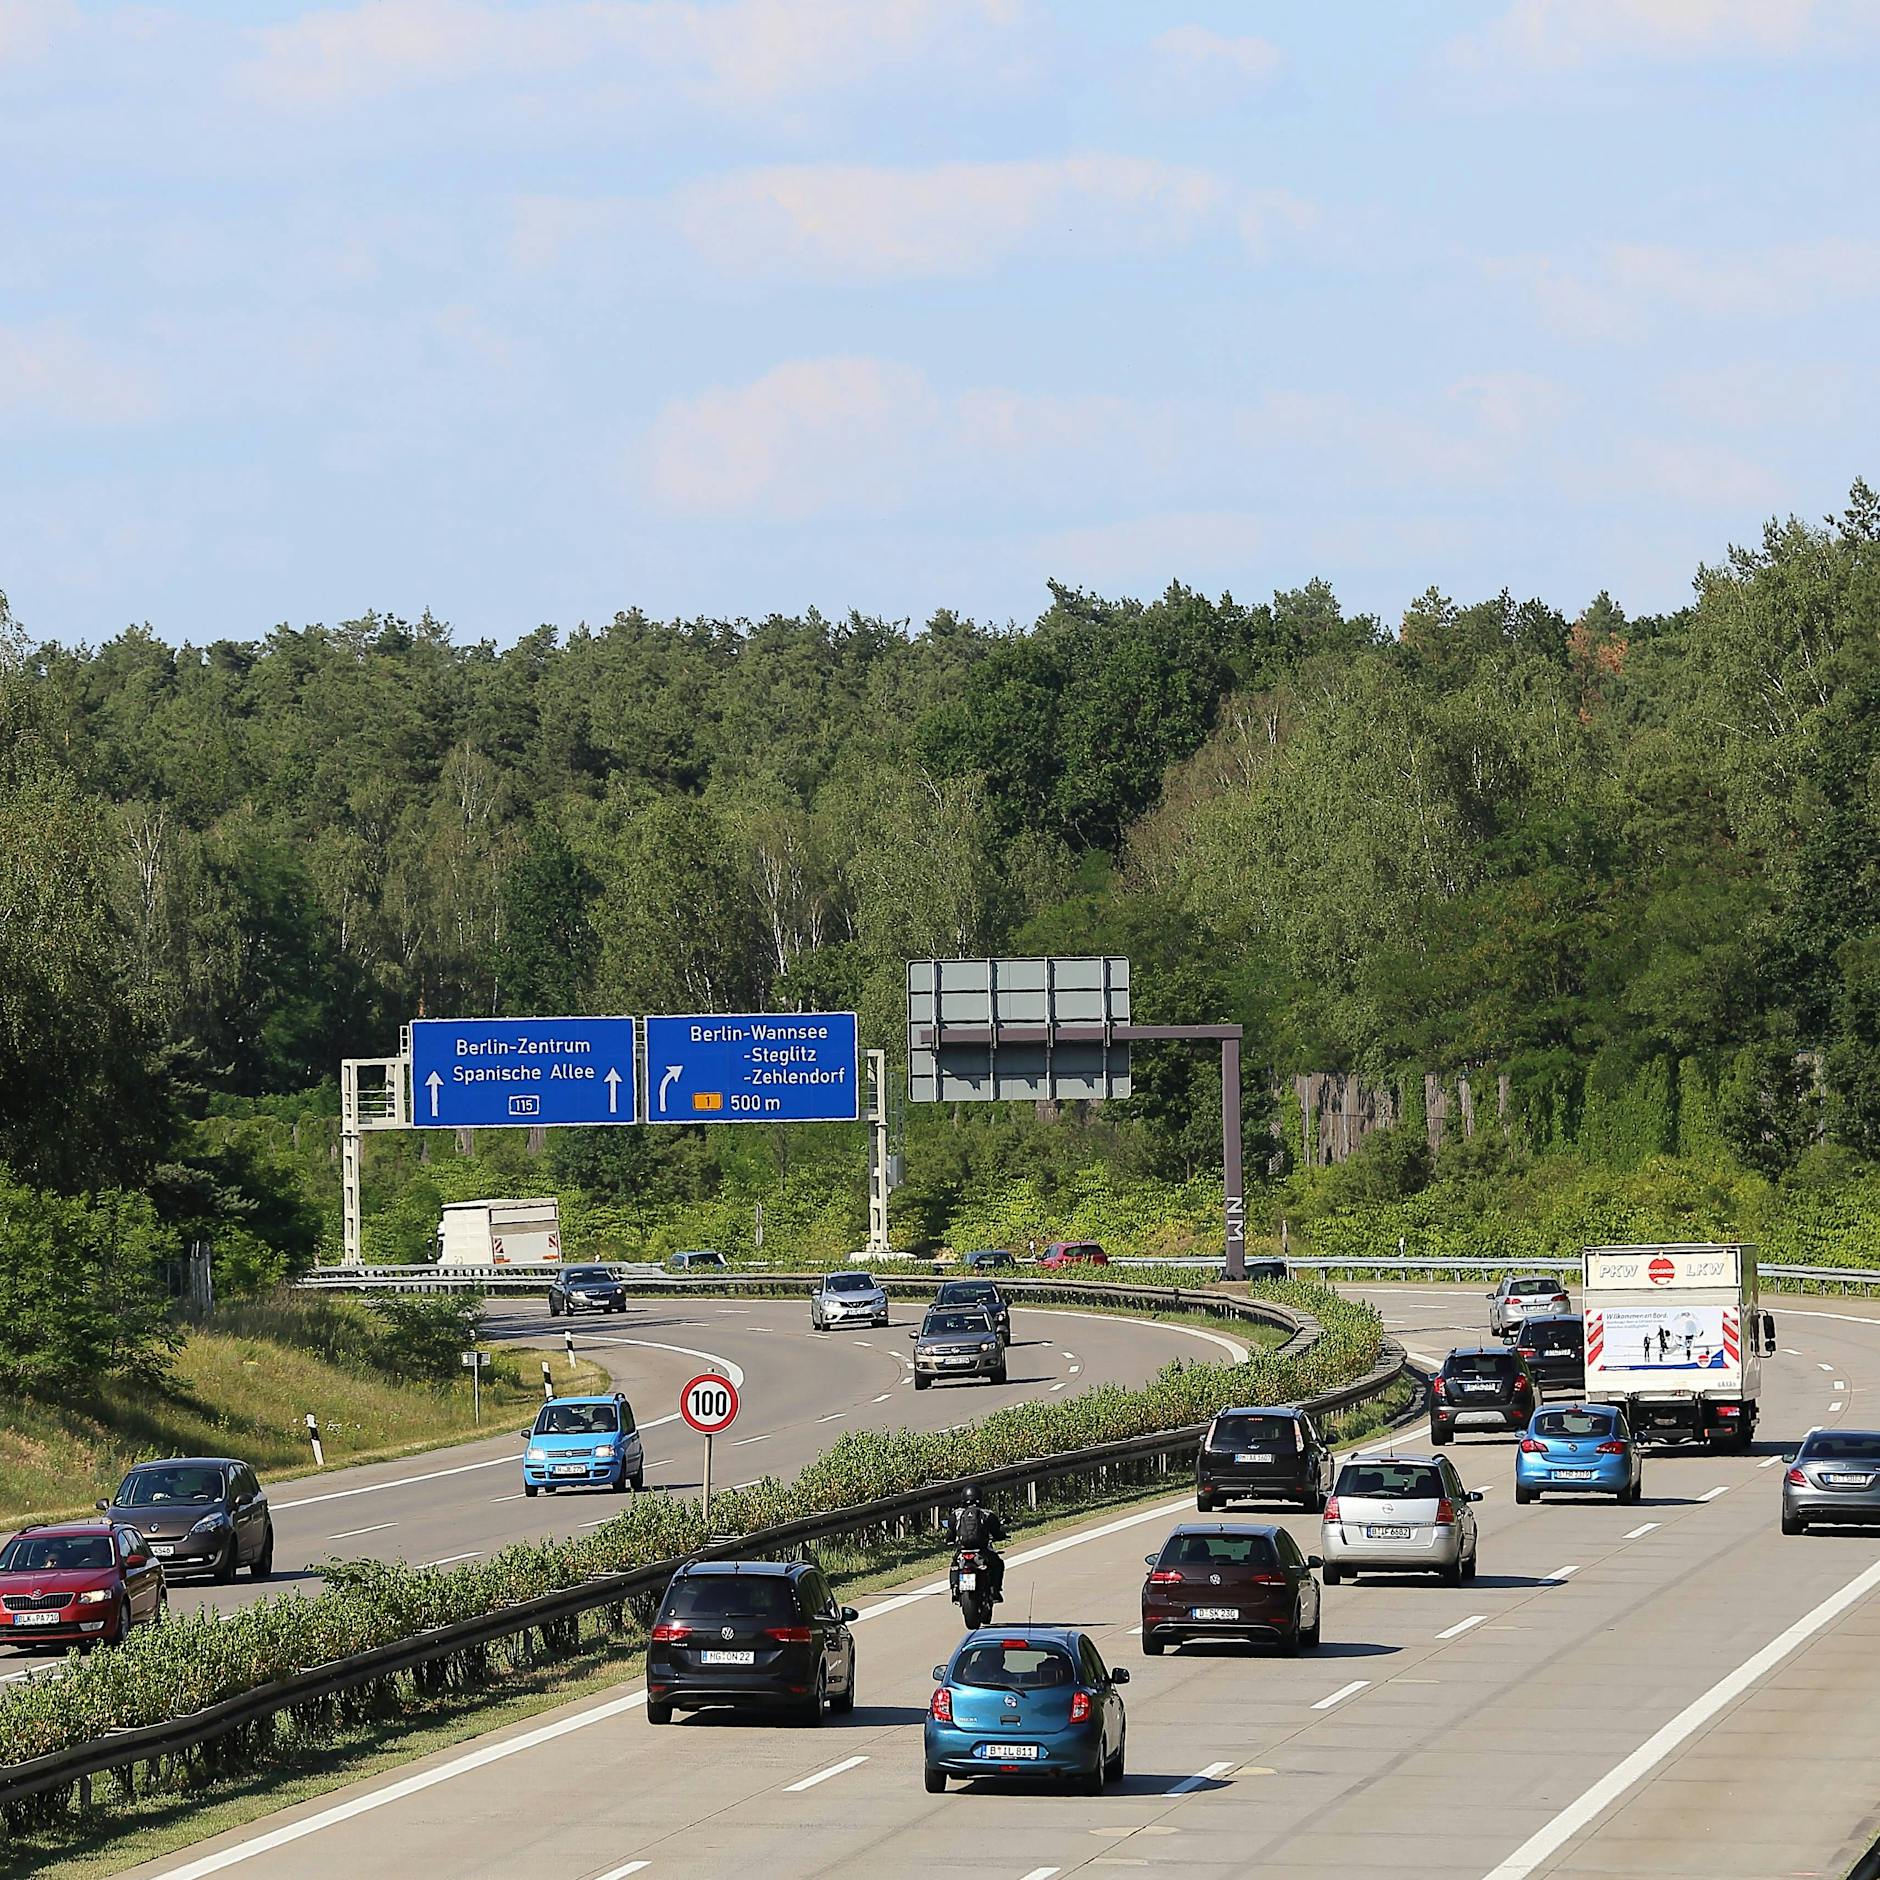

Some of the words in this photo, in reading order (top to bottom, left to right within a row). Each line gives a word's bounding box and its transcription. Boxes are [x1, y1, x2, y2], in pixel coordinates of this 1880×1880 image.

[690, 1025, 828, 1042] Berlin-Wannsee
[456, 1037, 591, 1056] Berlin-Zentrum
[743, 1046, 817, 1066] -Steglitz
[453, 1065, 542, 1085] Spanische
[550, 1064, 595, 1079] Allee
[743, 1067, 845, 1085] -Zehlendorf
[515, 1099, 533, 1112] 115
[704, 1096, 711, 1107] 1
[730, 1095, 761, 1111] 500
[765, 1098, 780, 1111] m
[1600, 1264, 1639, 1278] PKW
[1685, 1263, 1724, 1277] LKW
[692, 1390, 727, 1416] 100
